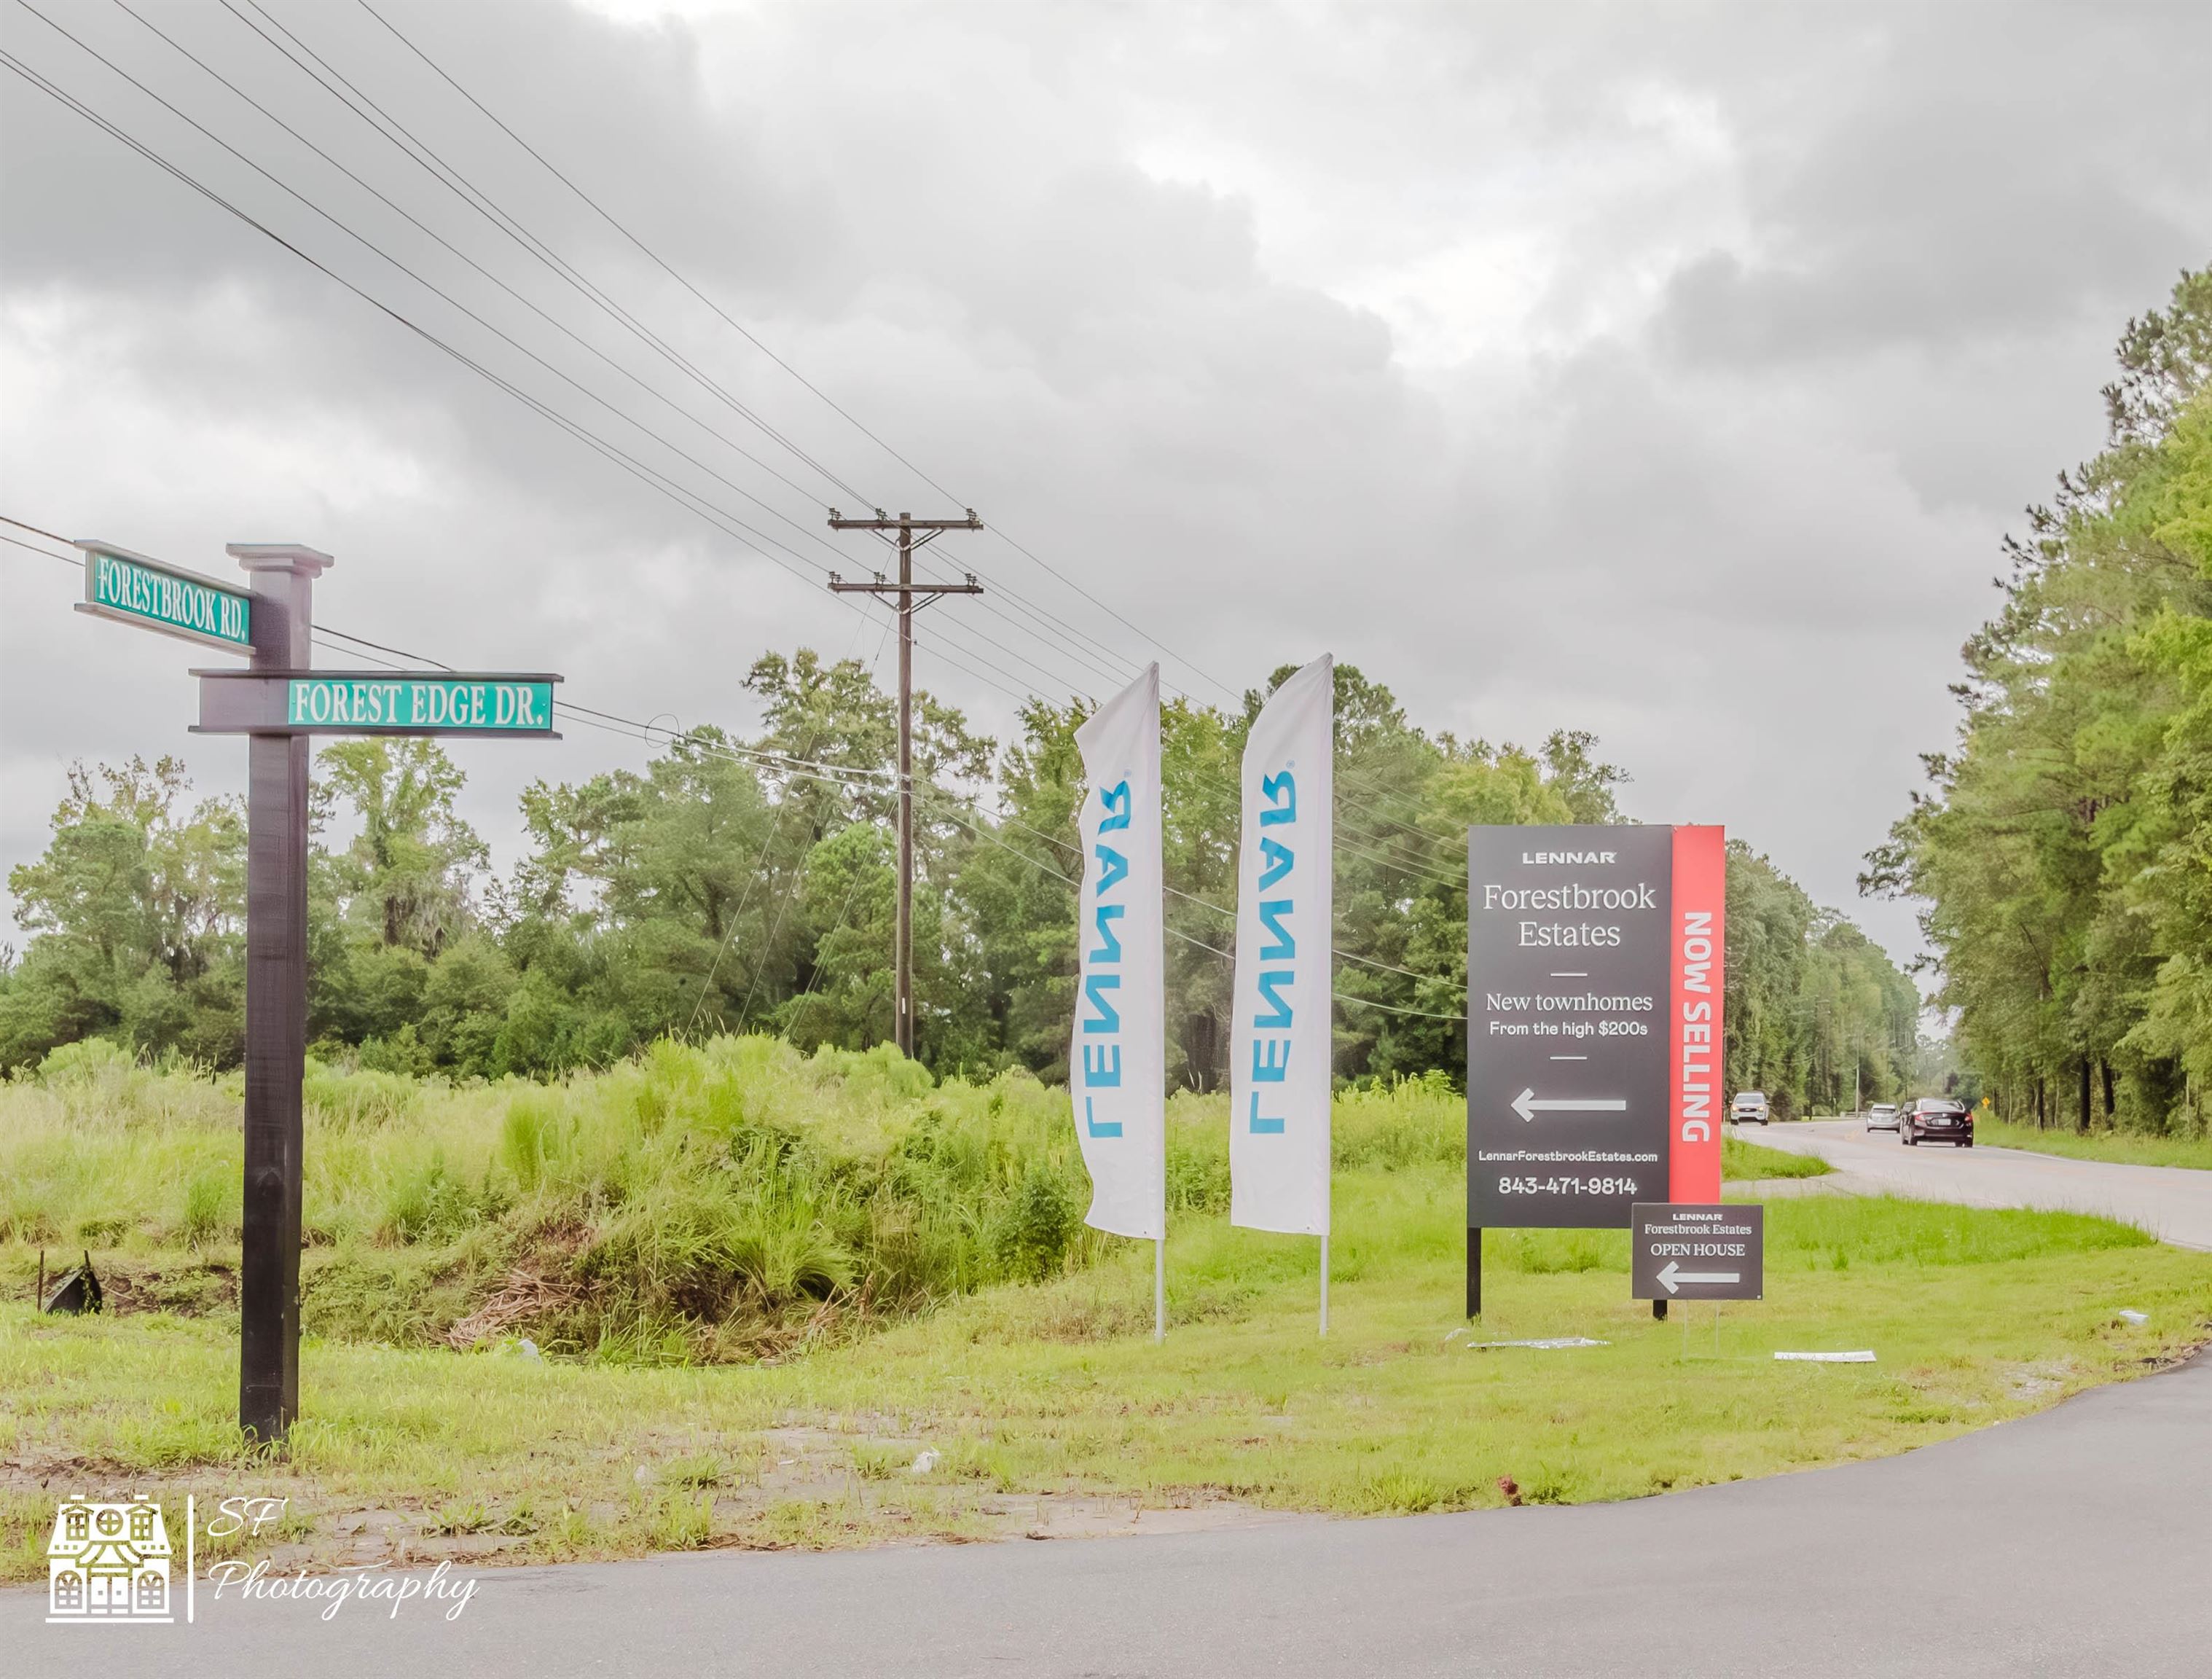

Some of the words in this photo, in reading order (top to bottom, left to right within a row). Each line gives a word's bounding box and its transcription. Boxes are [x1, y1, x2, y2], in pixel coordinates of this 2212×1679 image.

[98, 557, 216, 634] FORESTBROOK
[220, 595, 246, 641] RD.
[294, 682, 402, 723] FOREST
[411, 685, 485, 725] EDGE
[494, 686, 544, 726] DR.
[1522, 852, 1617, 865] LENNAR
[1483, 883, 1656, 910] Forestbrook
[1518, 921, 1621, 947] Estates
[1683, 912, 1712, 995] NOW
[1486, 993, 1531, 1011] New
[1535, 993, 1653, 1011] townhomes
[1489, 1021, 1529, 1036] From
[1533, 1021, 1558, 1036] the
[1562, 1021, 1594, 1039] high
[1598, 1020, 1648, 1038] $200s
[1682, 1001, 1711, 1143] SELLING
[1478, 1150, 1658, 1162] LennarForestbrookEstates.com
[1498, 1177, 1638, 1195] 843-471-9814
[1672, 1213, 1723, 1221] LENNAR
[1644, 1224, 1711, 1235] Forestbrook
[1712, 1224, 1752, 1235] Estates
[1650, 1243, 1691, 1256] OPEN
[1693, 1243, 1746, 1257] HOUSE
